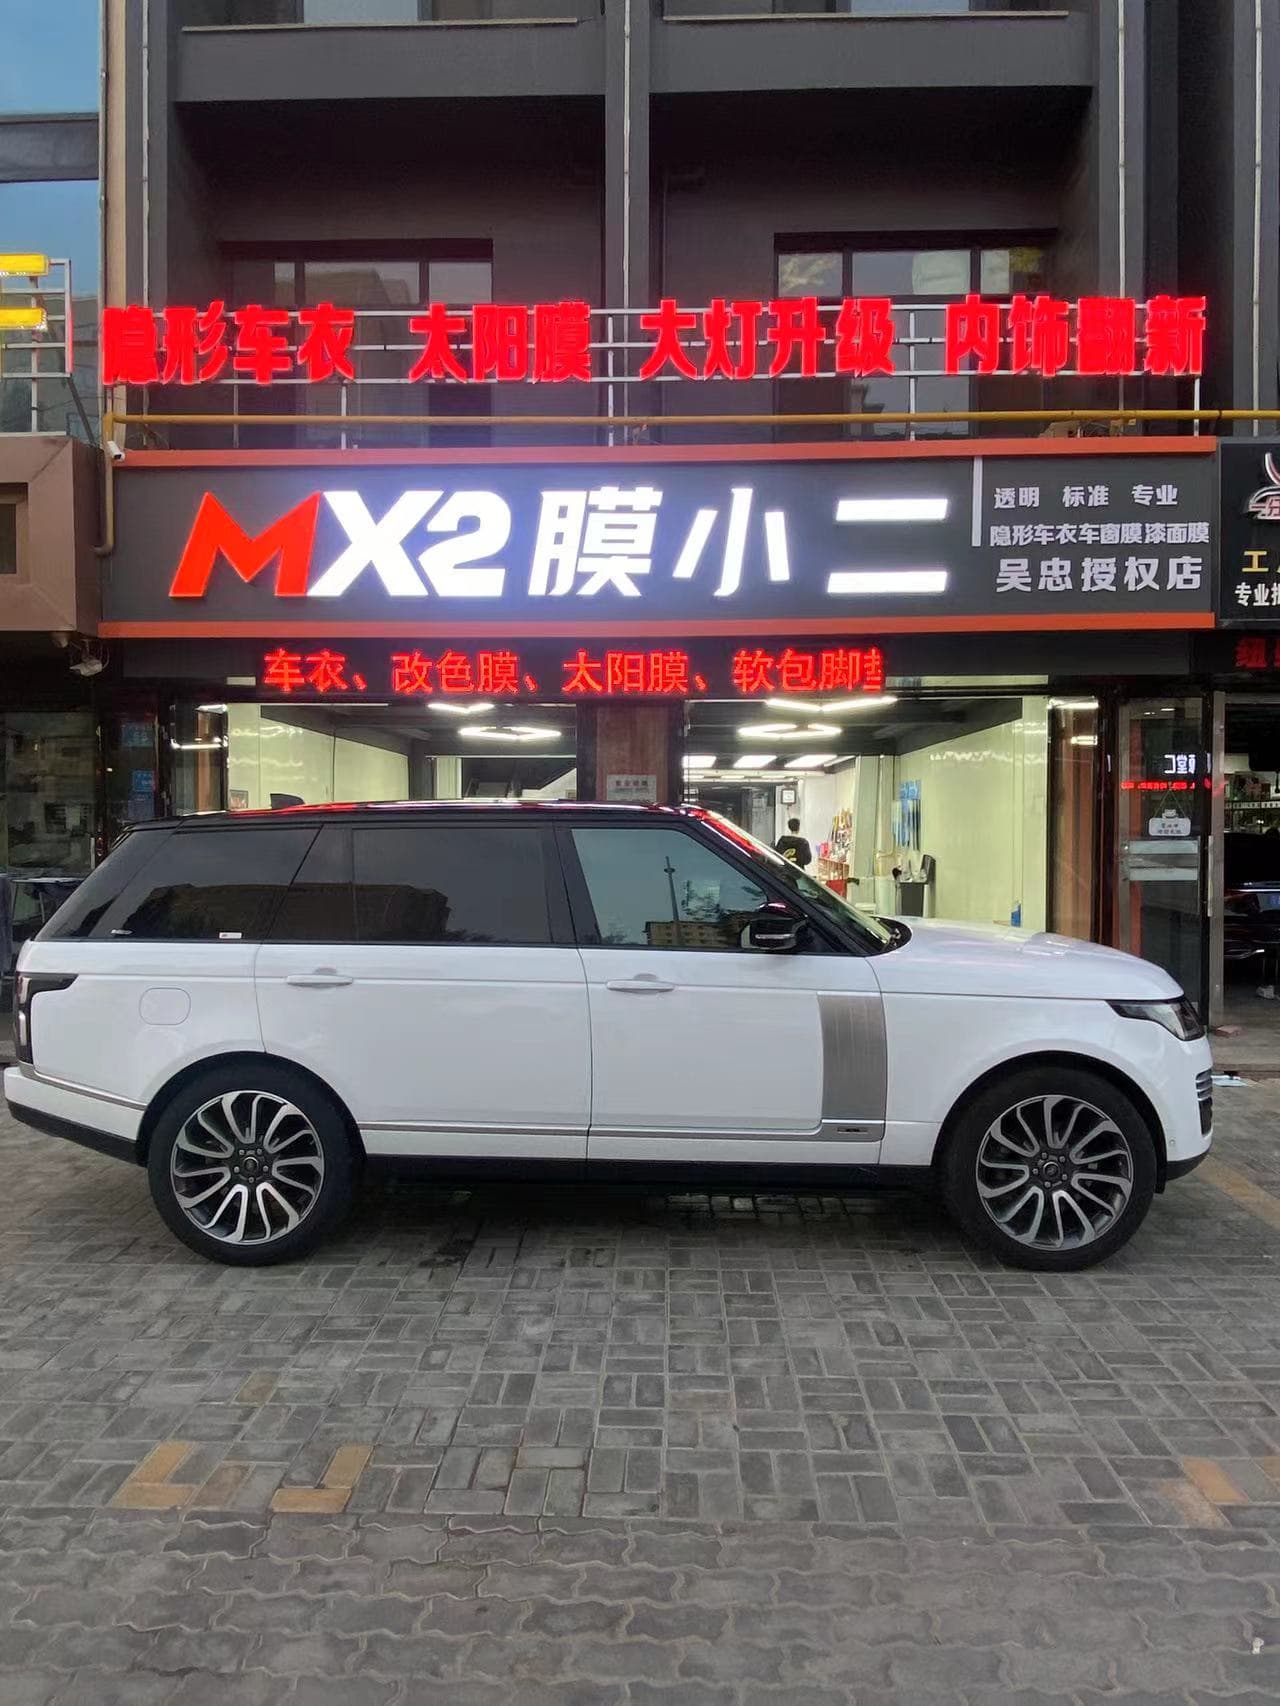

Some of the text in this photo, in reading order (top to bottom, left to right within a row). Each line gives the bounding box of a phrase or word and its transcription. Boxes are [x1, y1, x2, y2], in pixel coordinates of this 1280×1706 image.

[102, 293, 1207, 386] 隐形车衣 太阳膜 大灯升级 内饰翻新
[994, 484, 1178, 509] 透明 标准 专业
[996, 555, 1203, 593] 吴忠授权店
